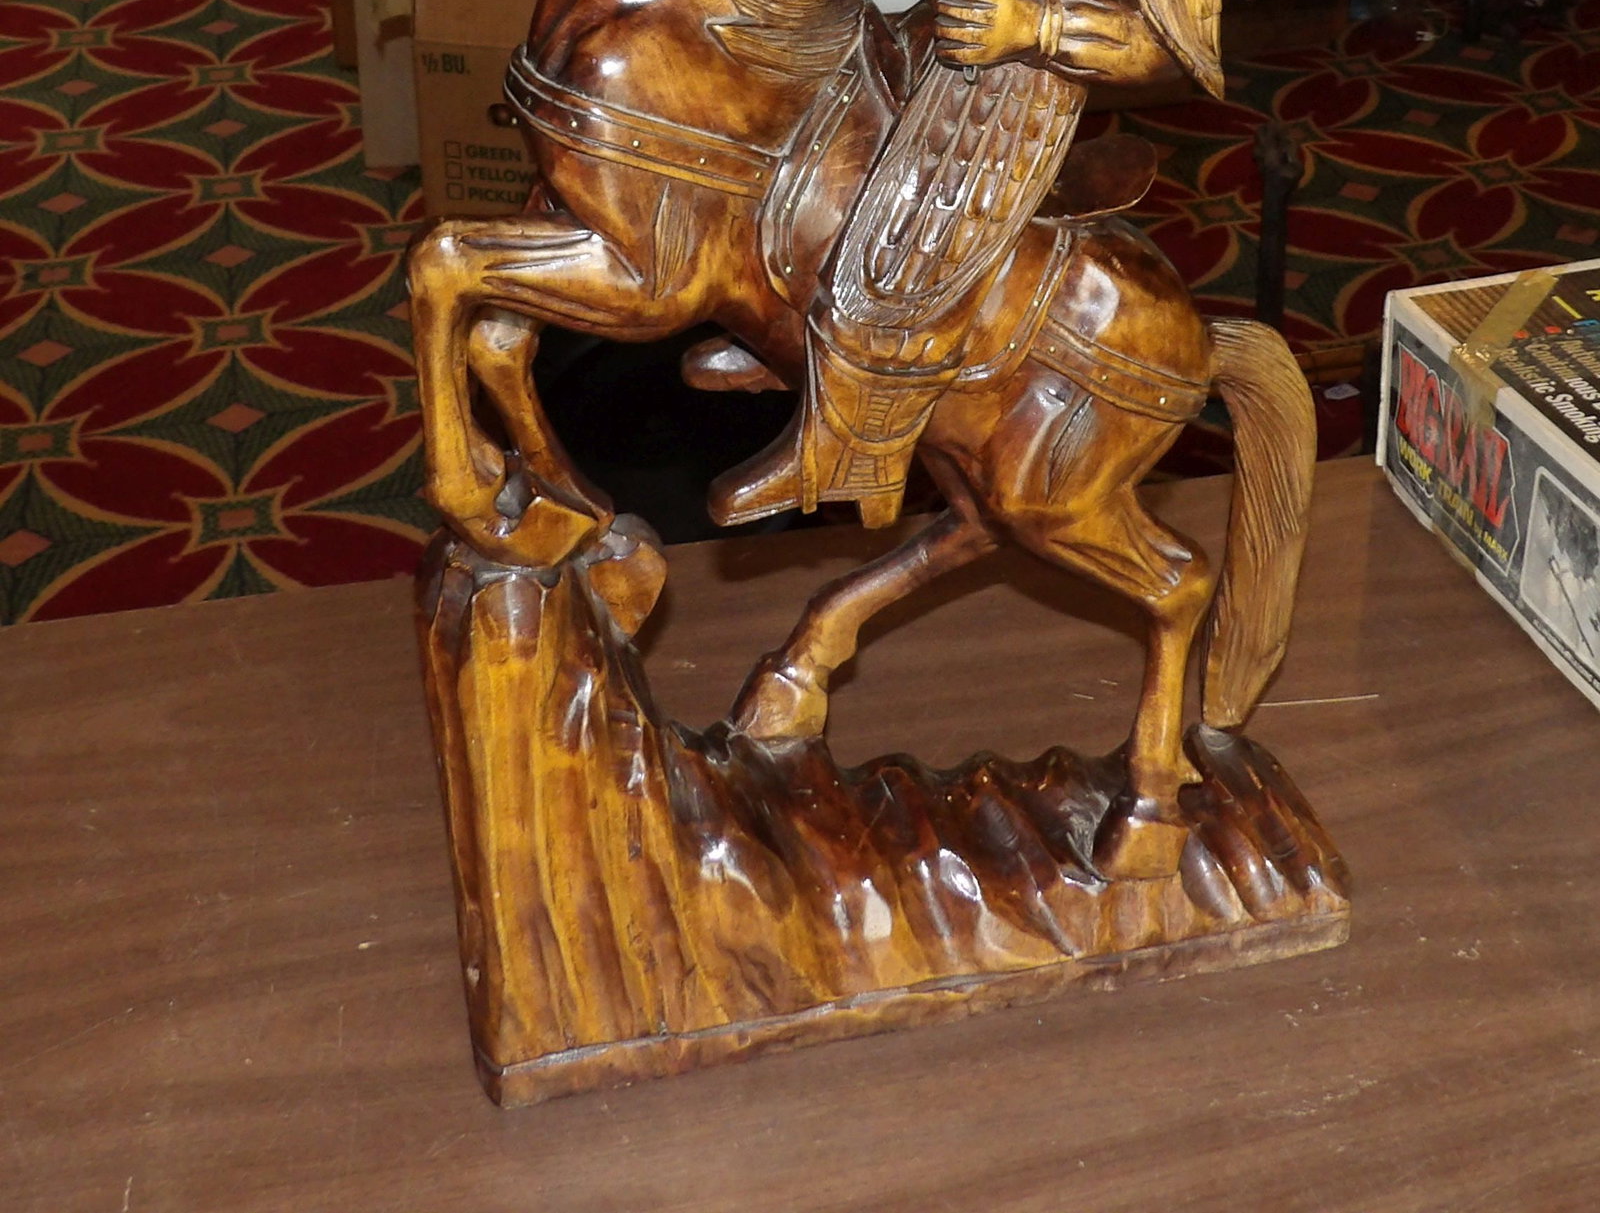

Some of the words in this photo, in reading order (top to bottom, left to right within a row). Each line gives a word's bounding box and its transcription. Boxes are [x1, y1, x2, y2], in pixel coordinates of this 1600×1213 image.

[466, 145, 522, 161] GREEN
[1497, 345, 1556, 395] Realistic
[1545, 393, 1600, 444] Smoking
[1399, 436, 1433, 484] WORK
[1437, 477, 1475, 527] TRAIN
[1483, 530, 1509, 564] MARX
